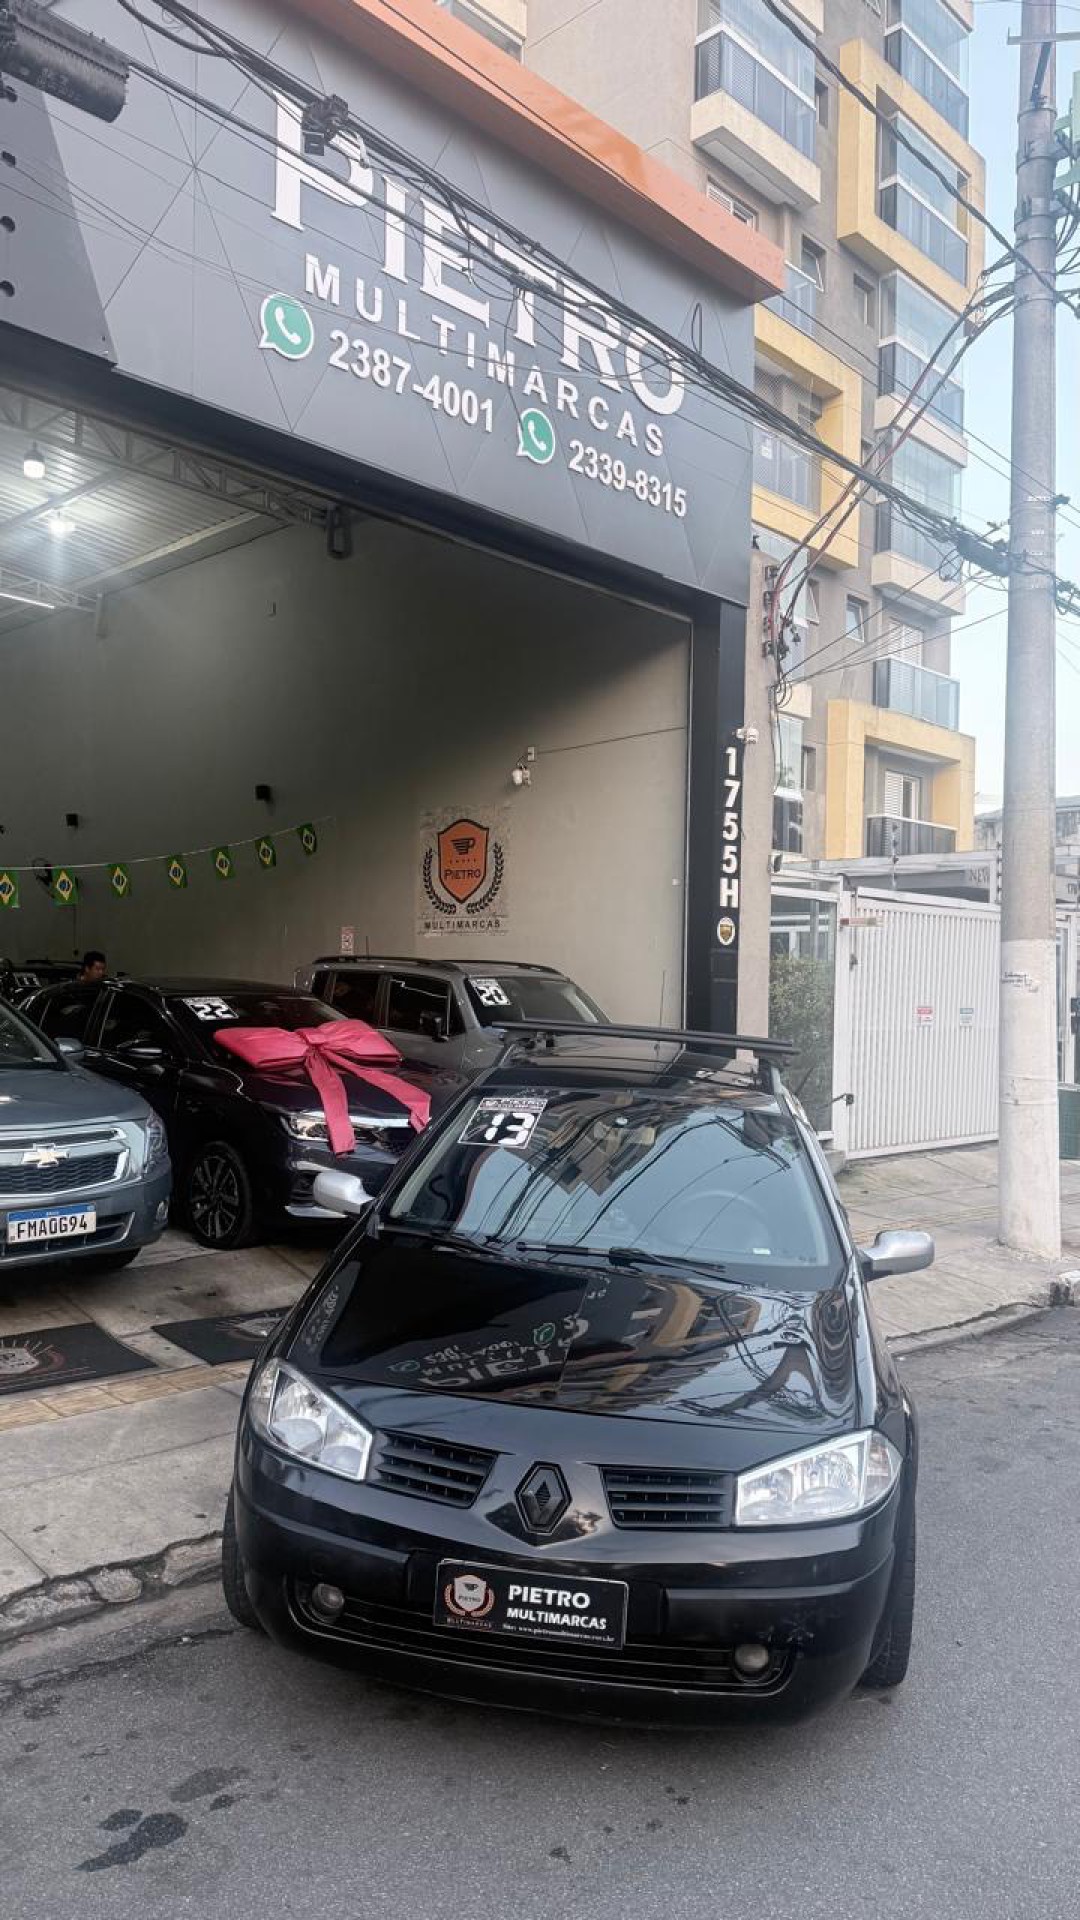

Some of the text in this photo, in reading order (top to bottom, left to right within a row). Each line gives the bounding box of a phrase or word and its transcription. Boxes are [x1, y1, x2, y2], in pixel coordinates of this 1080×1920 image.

[271, 90, 686, 415] PIETRO
[305, 253, 664, 457] MULTIMARCAS
[329, 330, 493, 433] 2387-4001
[568, 440, 688, 518] 2339-8315
[719, 747, 741, 908] 1755H
[444, 868, 481, 880] PIETRO
[424, 919, 501, 930] MULTIMARCAS
[478, 986, 508, 1005] 20
[194, 1004, 234, 1020] 22
[484, 1113, 535, 1145] 13
[508, 1584, 591, 1609] PIETRO
[507, 1607, 607, 1630] MULTIMARCAS
